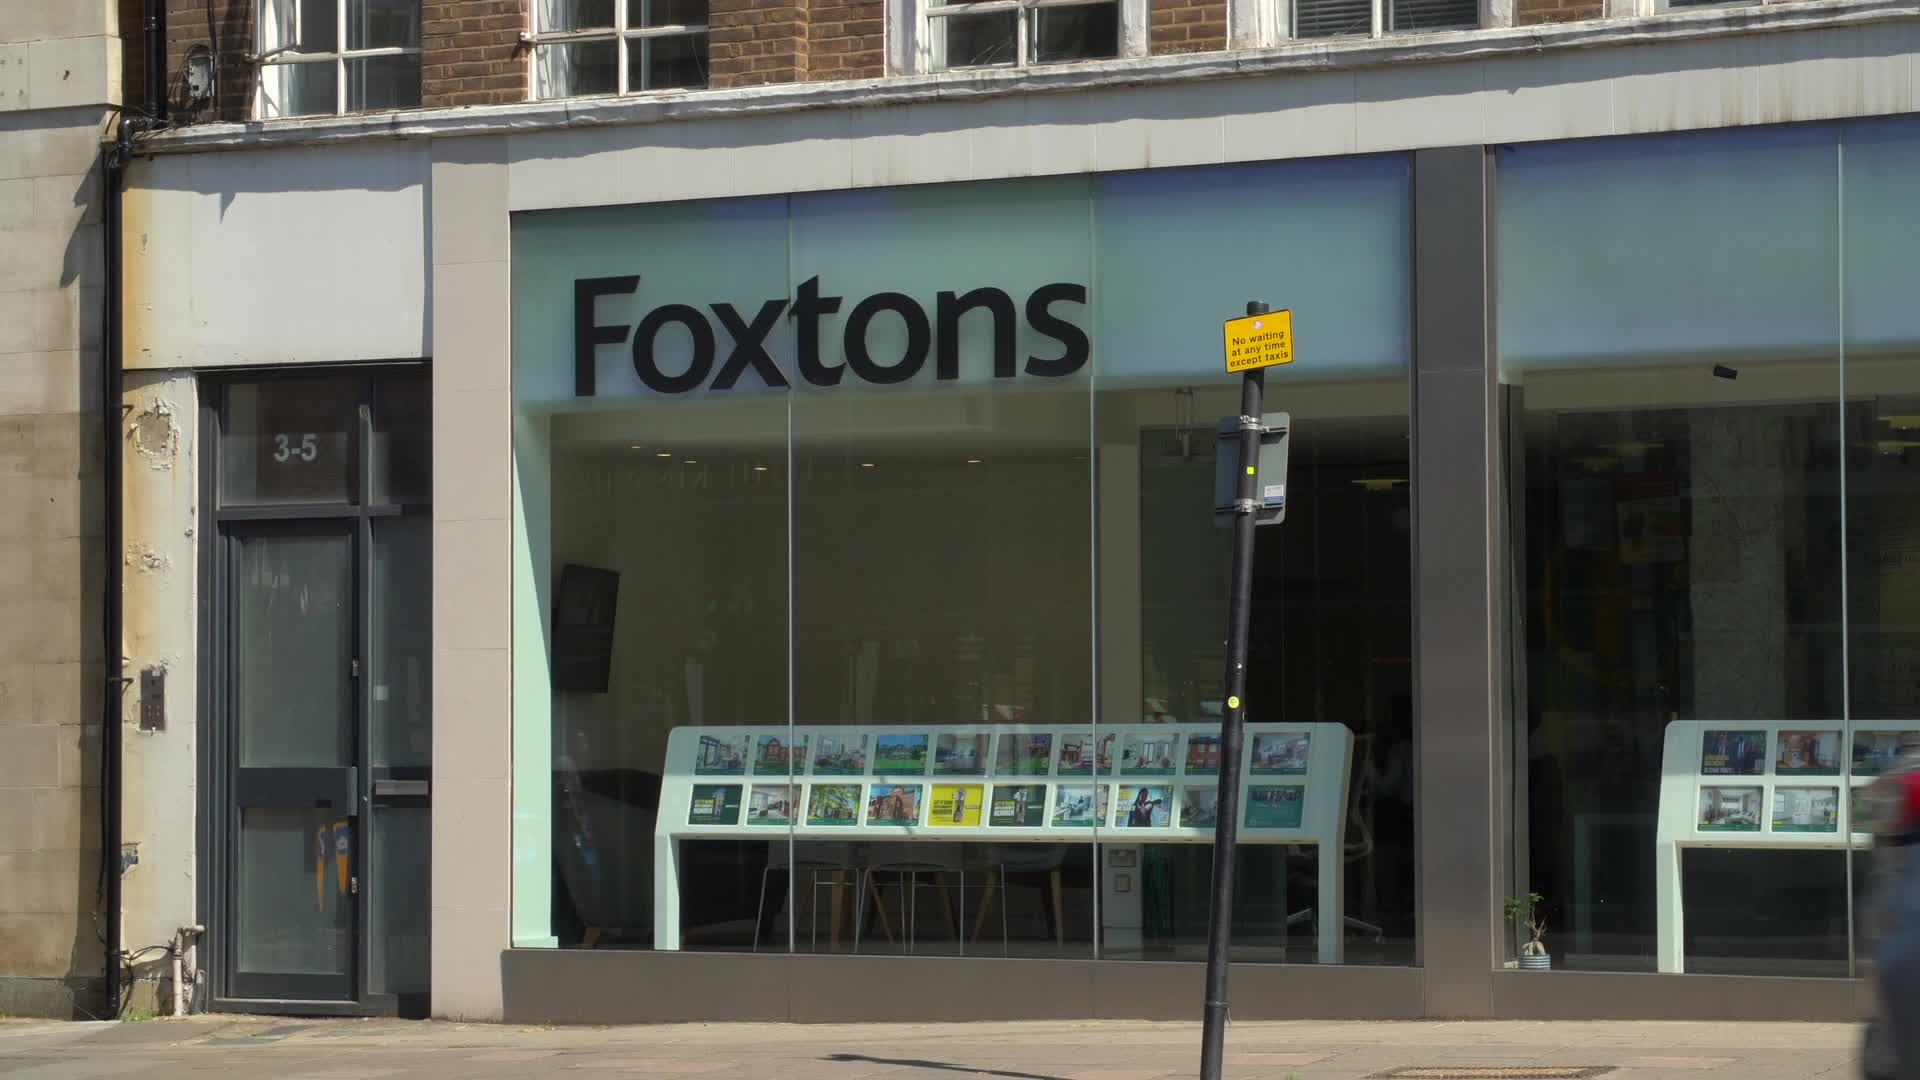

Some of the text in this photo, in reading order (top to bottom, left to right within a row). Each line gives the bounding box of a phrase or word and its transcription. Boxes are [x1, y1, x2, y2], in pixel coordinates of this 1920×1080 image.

[574, 275, 1090, 397] Foxtons
[1232, 331, 1284, 346] No waiting
[1231, 341, 1286, 357] at any time
[1230, 350, 1289, 367] except taxis
[274, 433, 317, 462] 3-5
